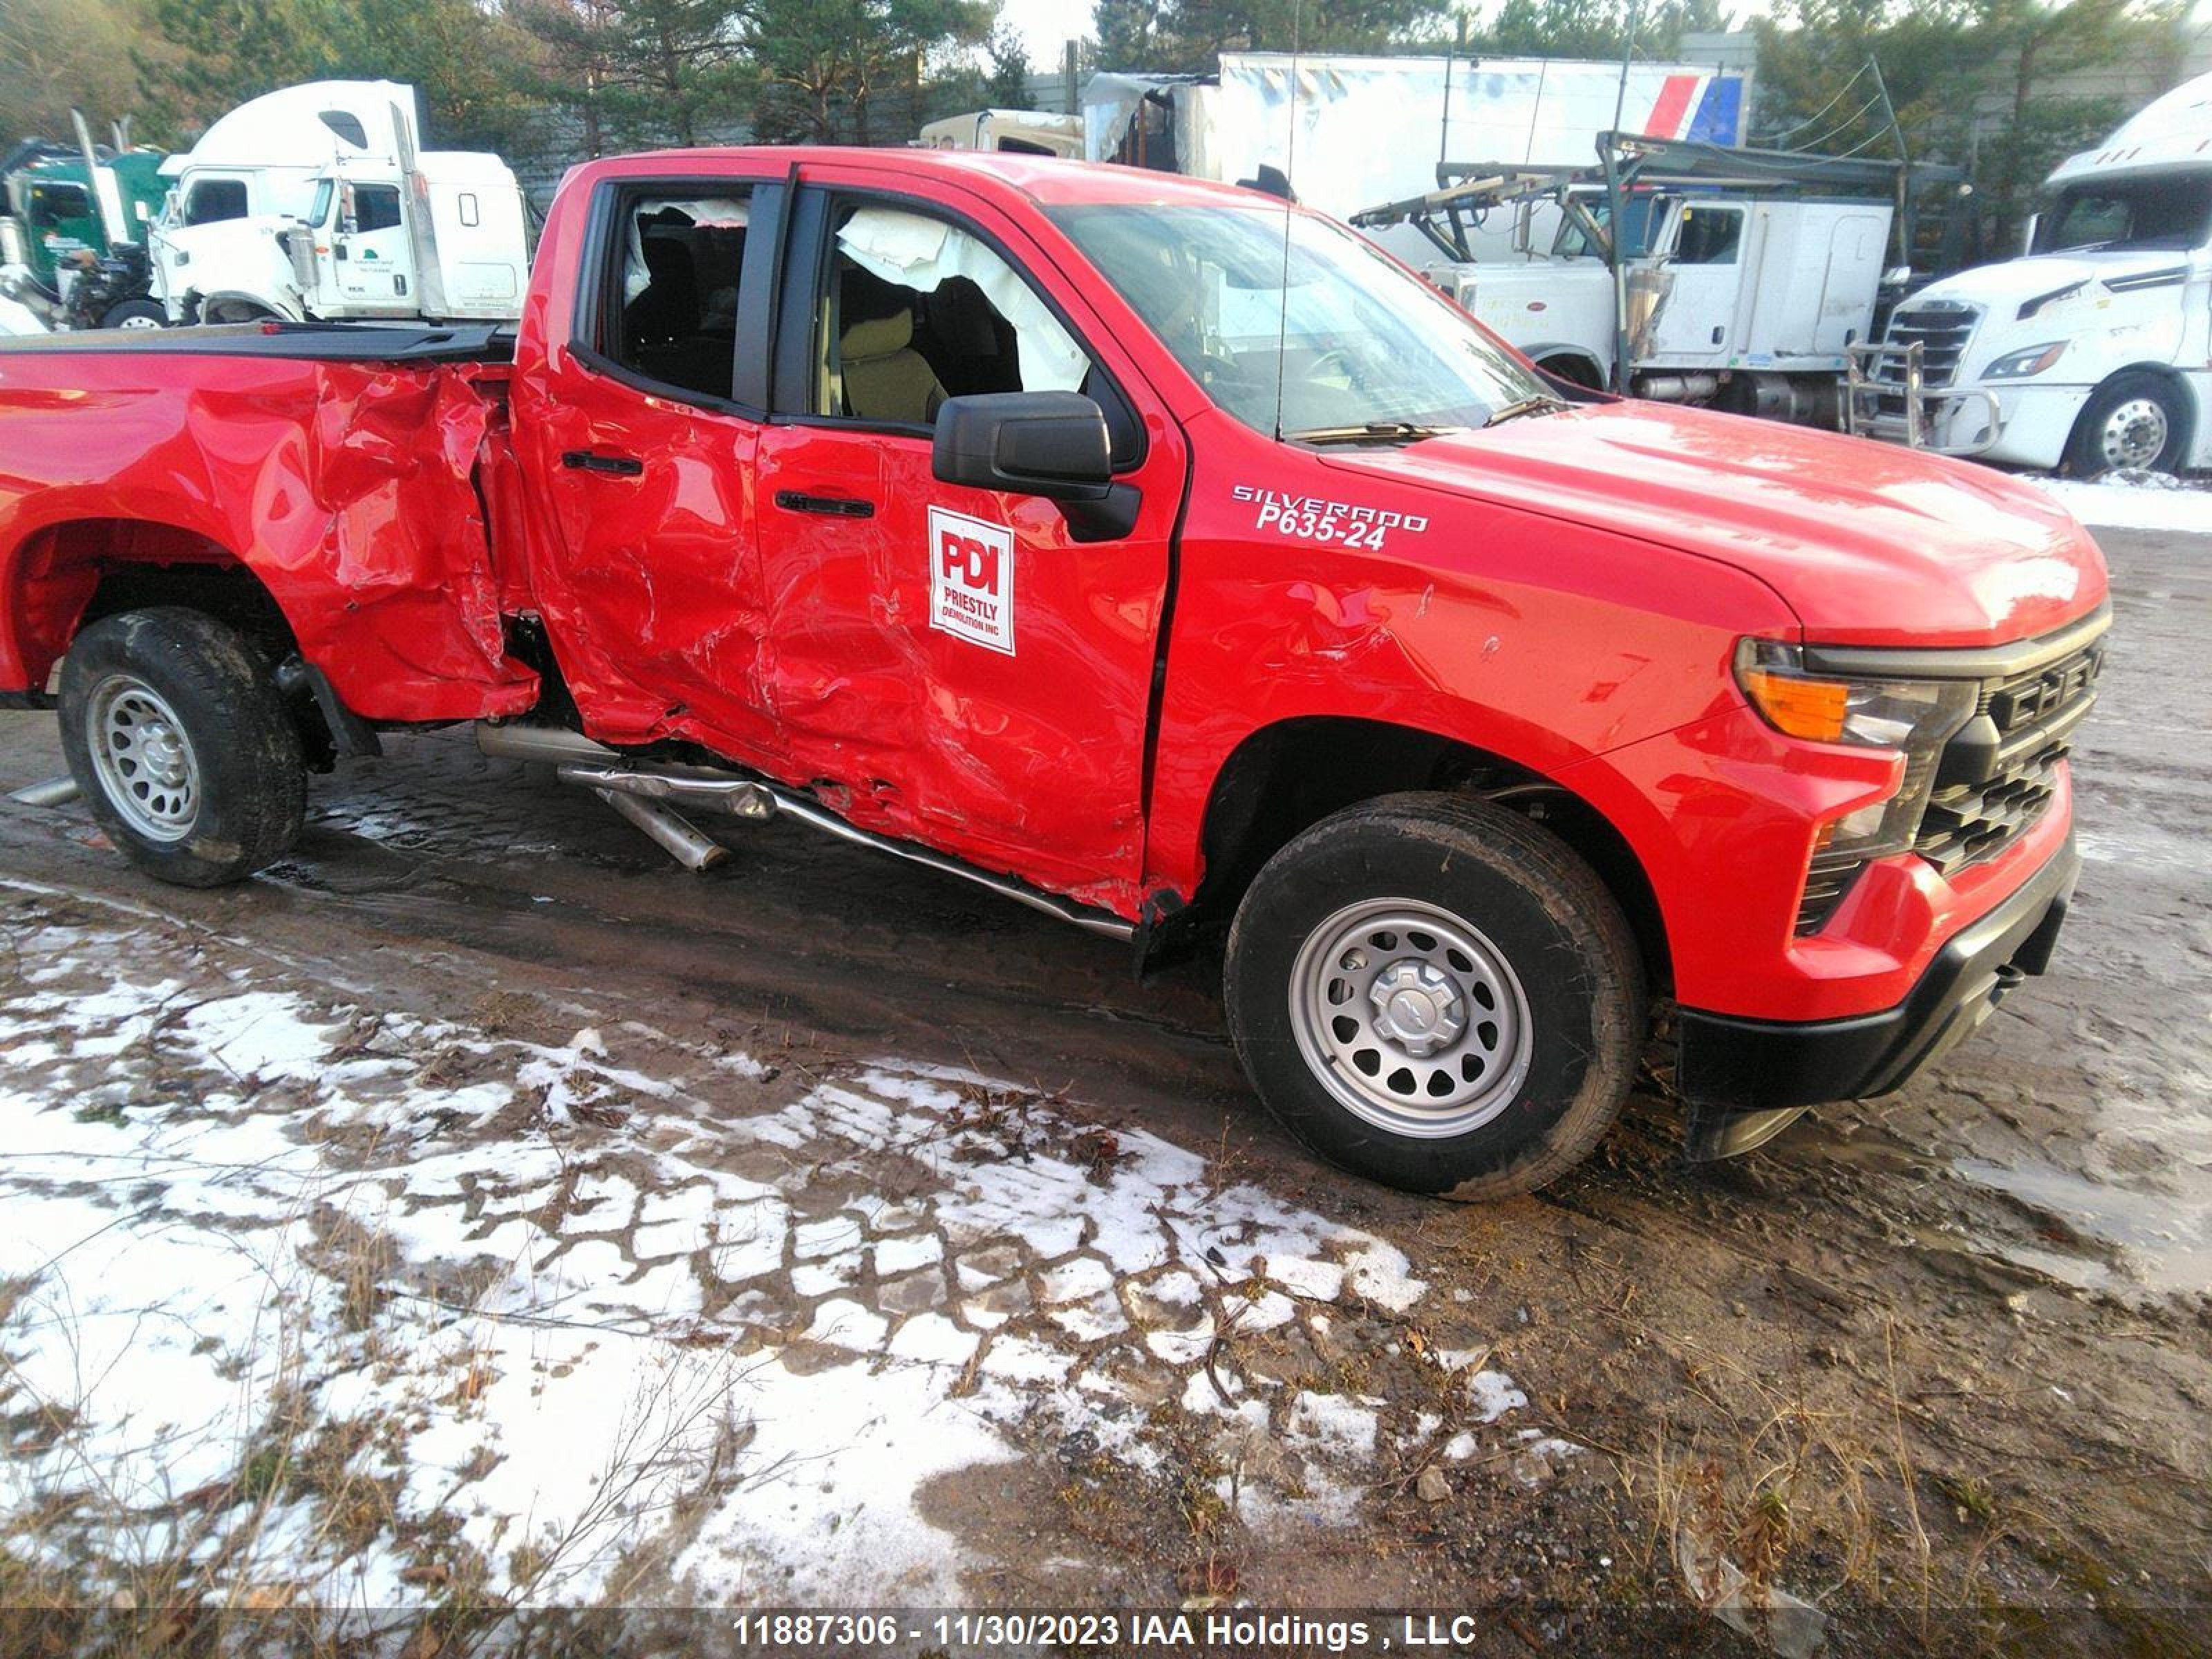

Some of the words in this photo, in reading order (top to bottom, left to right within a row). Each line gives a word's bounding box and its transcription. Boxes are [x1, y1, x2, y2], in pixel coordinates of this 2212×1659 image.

[1232, 485, 1430, 532] SILVERADO
[1256, 504, 1385, 551] P635-24
[941, 529, 998, 596] PDI
[942, 606, 984, 631] DEMOLITION
[944, 585, 998, 621] PRIESTLY
